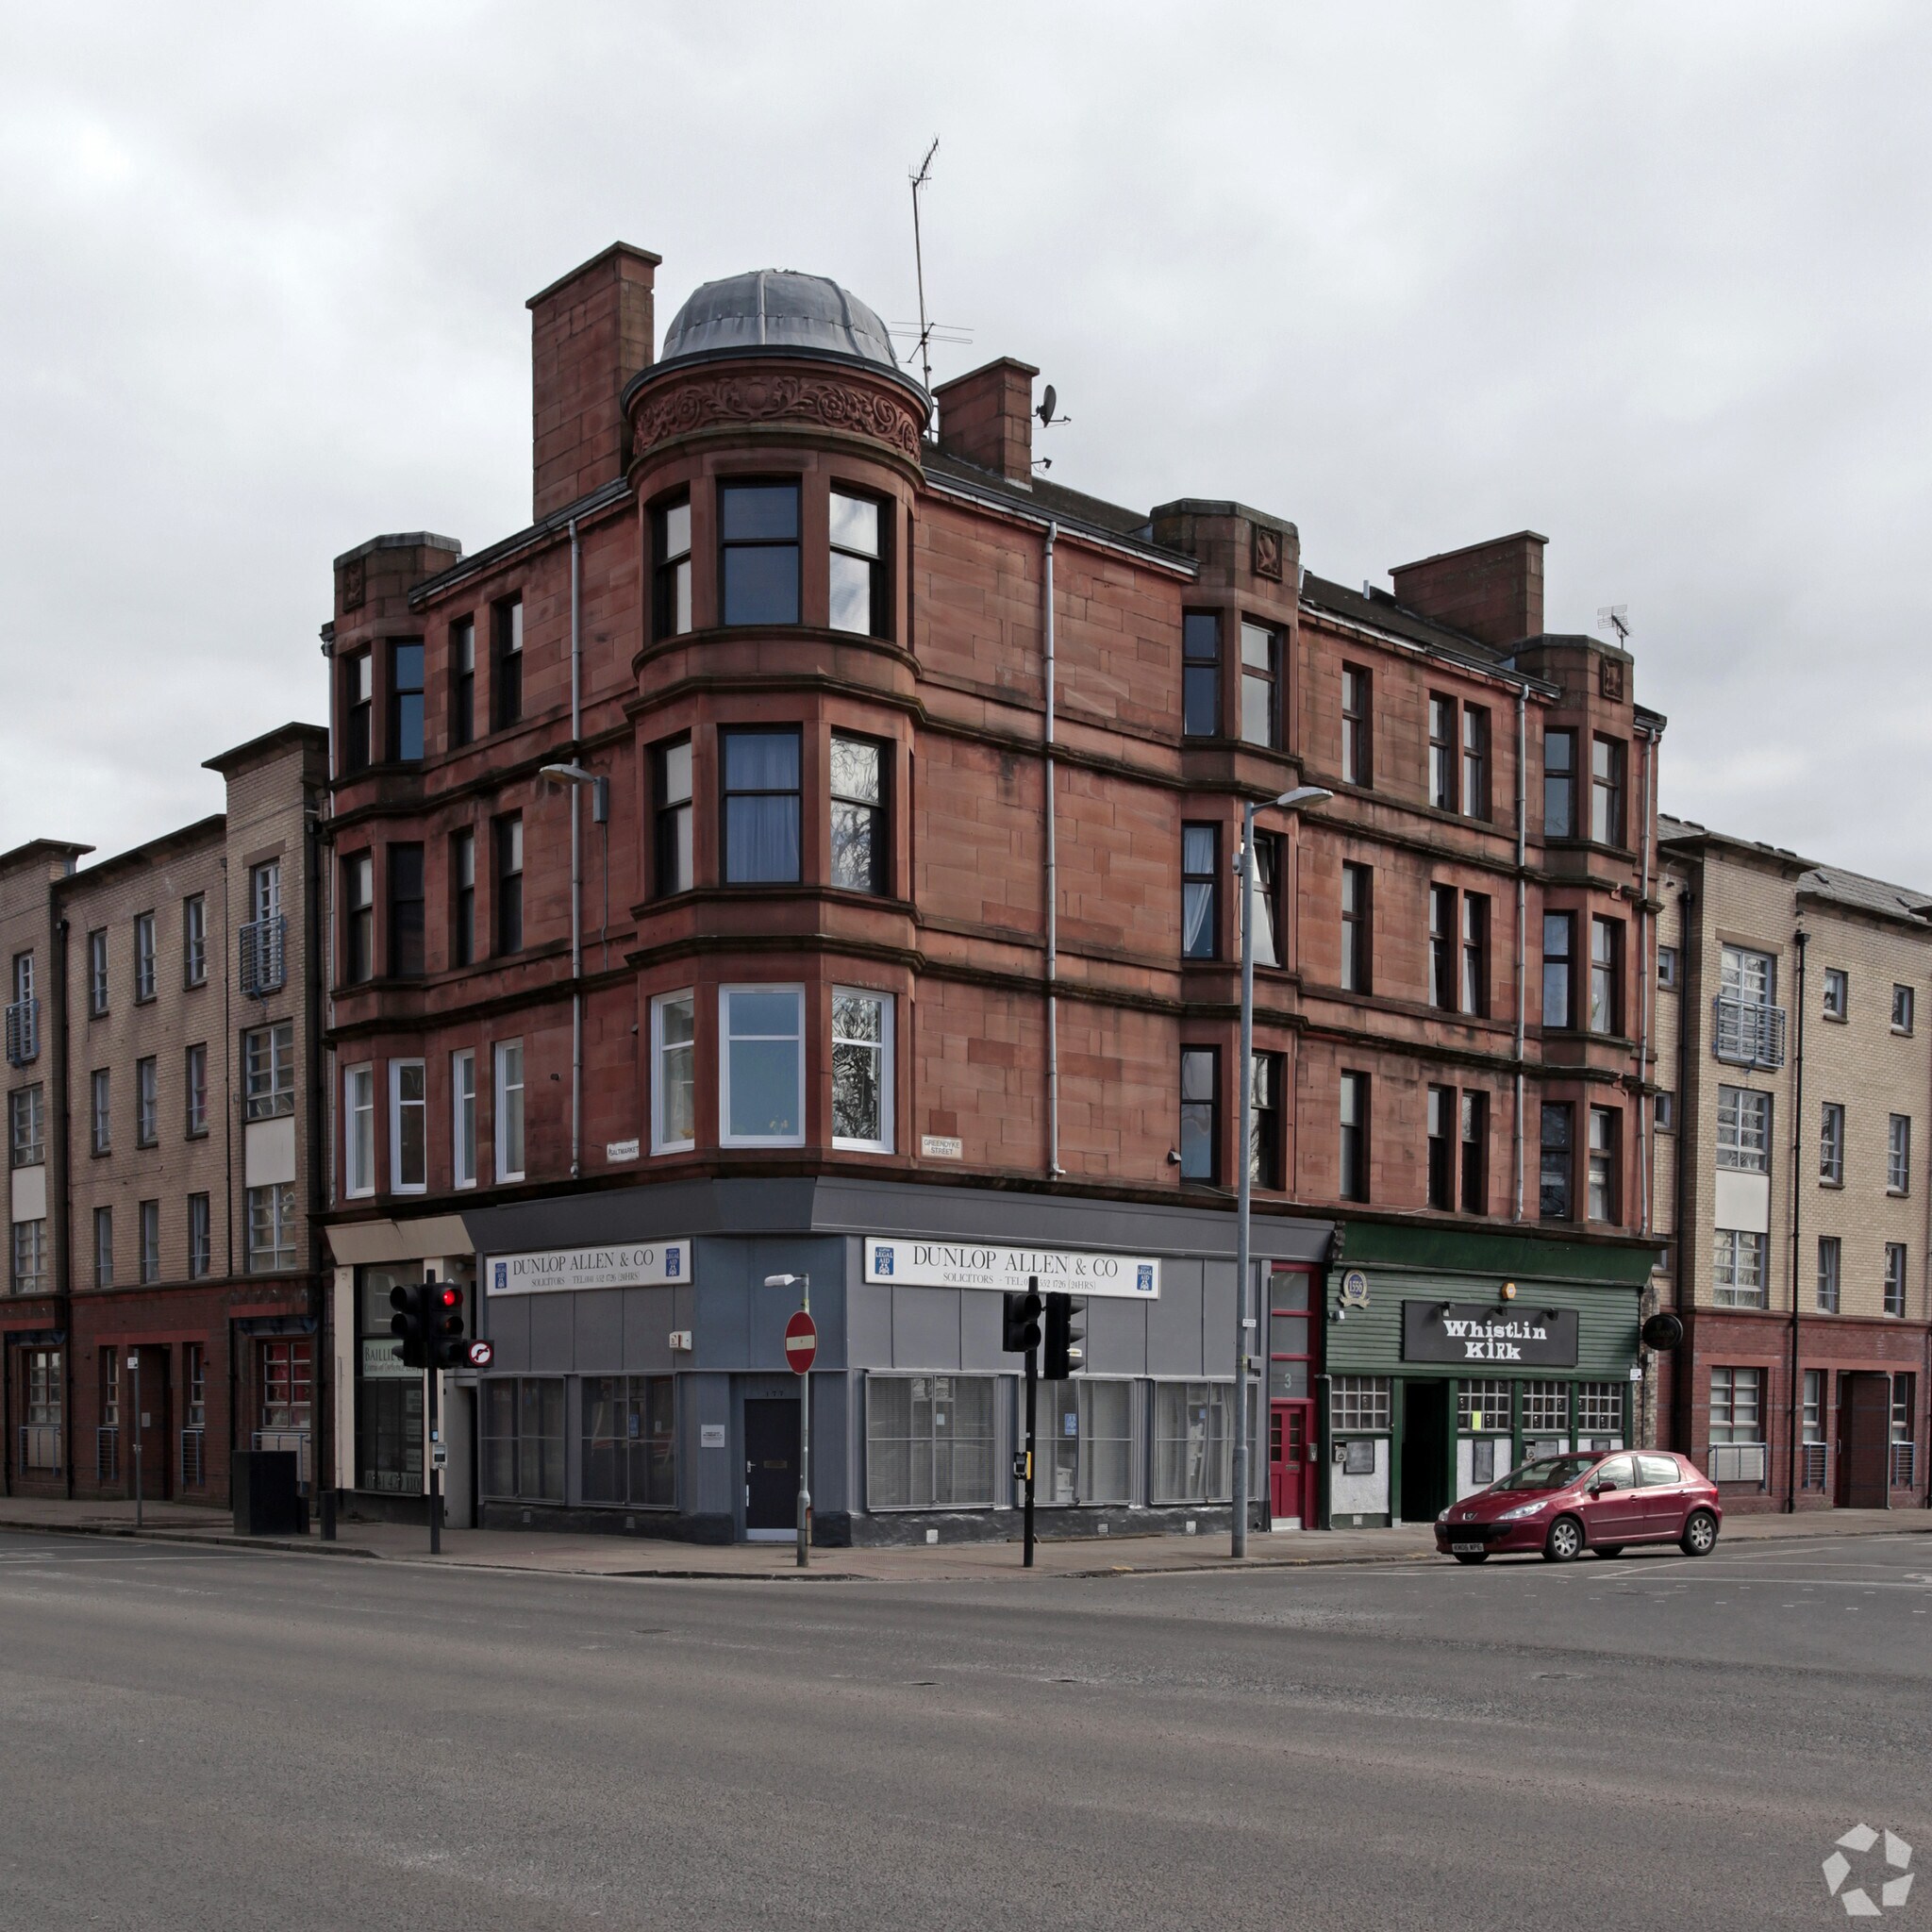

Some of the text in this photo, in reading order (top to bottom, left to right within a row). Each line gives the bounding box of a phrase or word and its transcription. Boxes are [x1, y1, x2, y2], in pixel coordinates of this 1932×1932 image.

[610, 1146, 639, 1156] SALTMARKET
[924, 1140, 959, 1148] GREENDYKE
[512, 1248, 655, 1275] DUNLOP ALLEN & CO
[913, 1245, 1118, 1278] DUNLOP ALLEN & CO
[531, 1276, 565, 1287] SOLICITORS
[943, 1273, 994, 1284] SOLICITORS
[1039, 1279, 1050, 1288] 552
[1053, 1279, 1066, 1289] 1726
[1068, 1279, 1096, 1291] (24HRS)
[1284, 1373, 1292, 1389] 3
